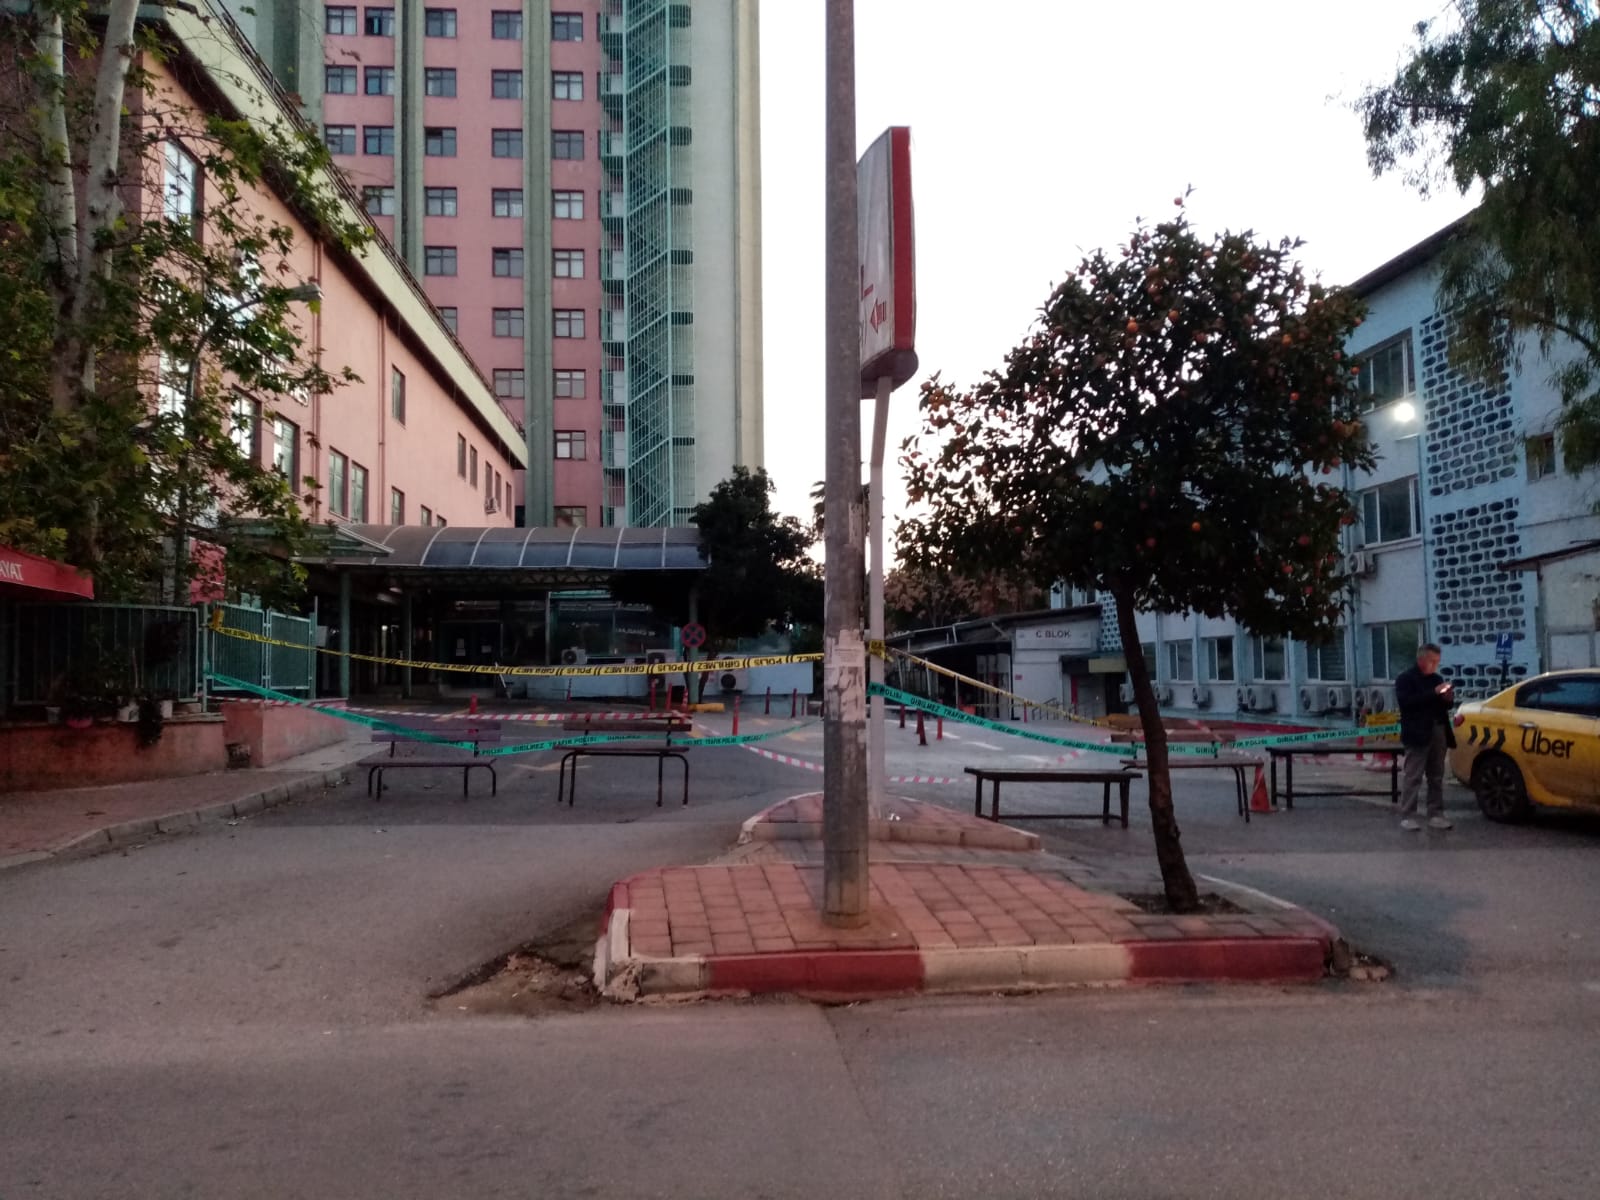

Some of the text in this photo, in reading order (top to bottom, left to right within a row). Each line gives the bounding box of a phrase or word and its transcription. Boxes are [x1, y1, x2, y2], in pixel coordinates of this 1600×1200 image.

[1045, 630, 1071, 638] BLOK
[1501, 633, 1509, 645] P
[1521, 728, 1575, 759] Uber
